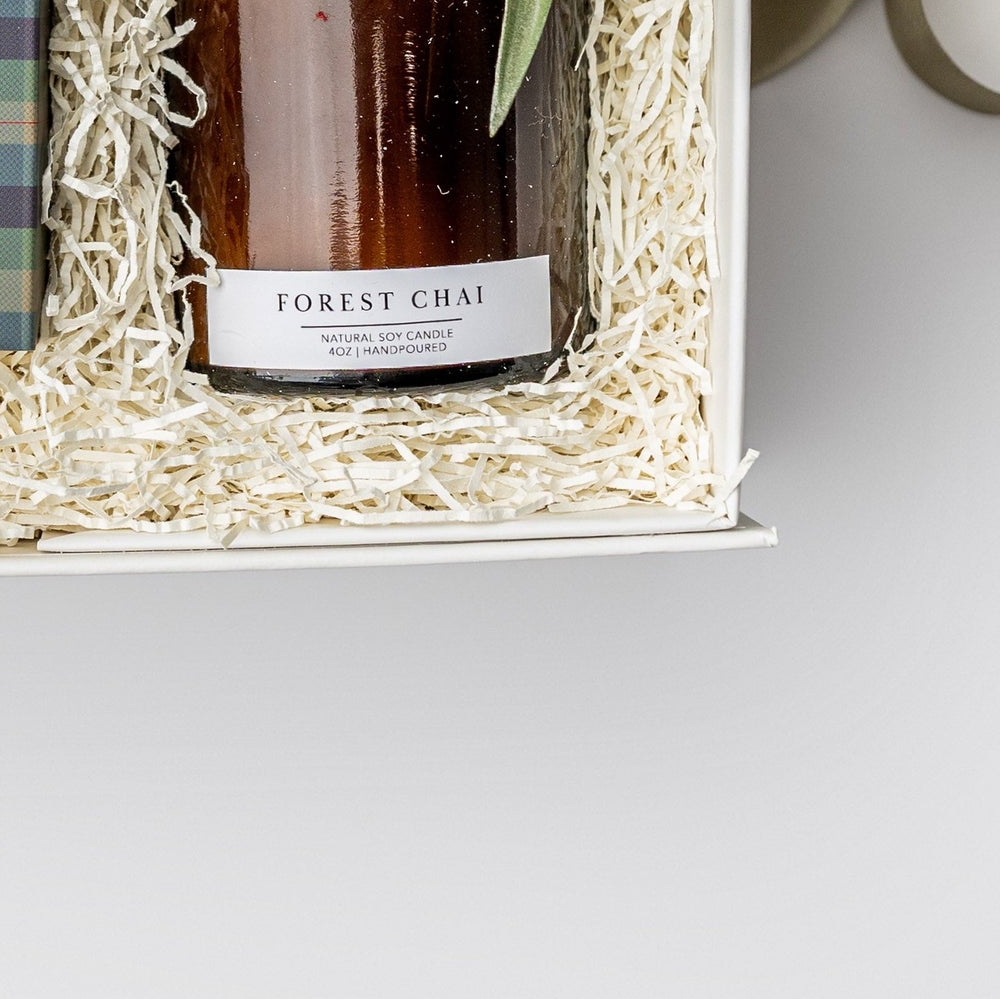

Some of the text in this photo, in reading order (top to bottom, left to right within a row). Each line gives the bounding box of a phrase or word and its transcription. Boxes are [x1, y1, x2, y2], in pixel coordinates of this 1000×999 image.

[278, 285, 485, 312] FOREST CHAI
[321, 328, 454, 344] NATURAL SOY CANDLE
[363, 342, 447, 356] HANDPOURED
